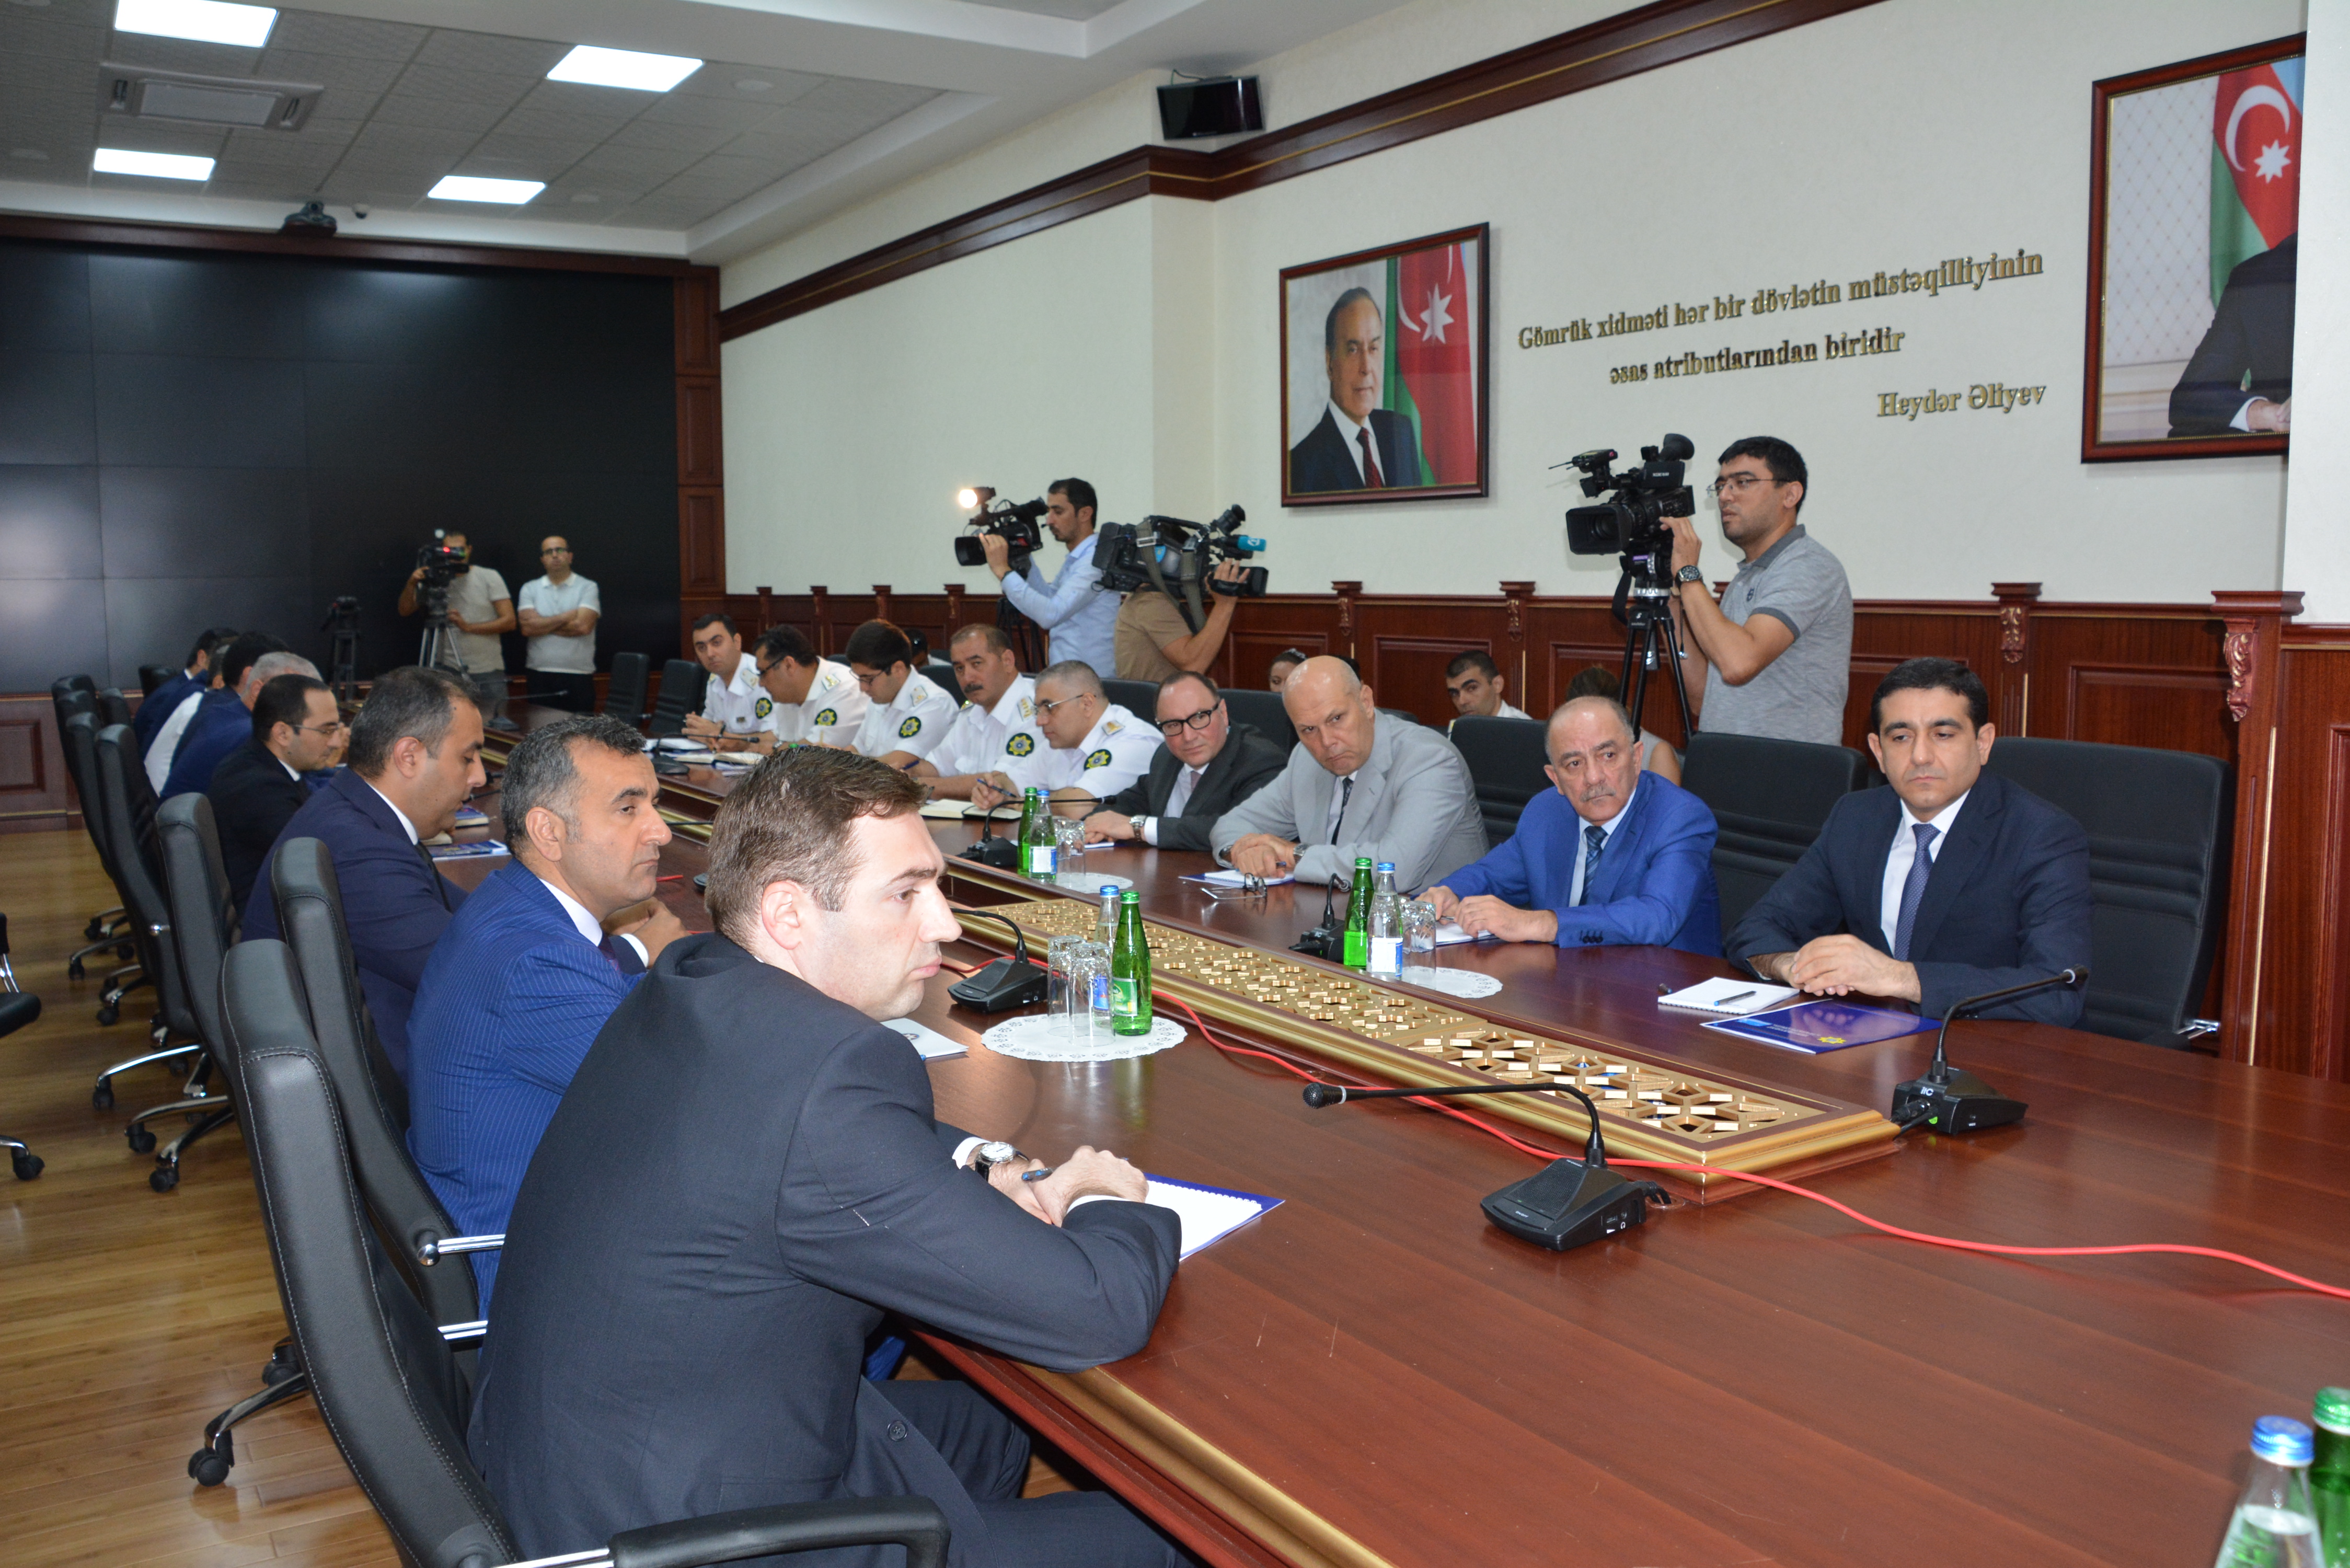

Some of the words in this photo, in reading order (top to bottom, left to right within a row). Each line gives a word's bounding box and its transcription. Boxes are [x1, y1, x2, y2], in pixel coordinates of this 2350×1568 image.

[1518, 318, 1593, 349] Gömrük
[1597, 304, 1668, 338] xidməti
[1674, 302, 1709, 326] hər
[1713, 294, 1745, 320] bir
[1751, 279, 1841, 315] dövlətin
[1848, 248, 2043, 301] müstəqilliyinin
[1610, 363, 1648, 384] əsas
[1653, 339, 1818, 379] atributlarından
[1824, 326, 1906, 360] biridir
[1877, 389, 1961, 421] Heydər
[1967, 382, 2046, 414] Əliyev
